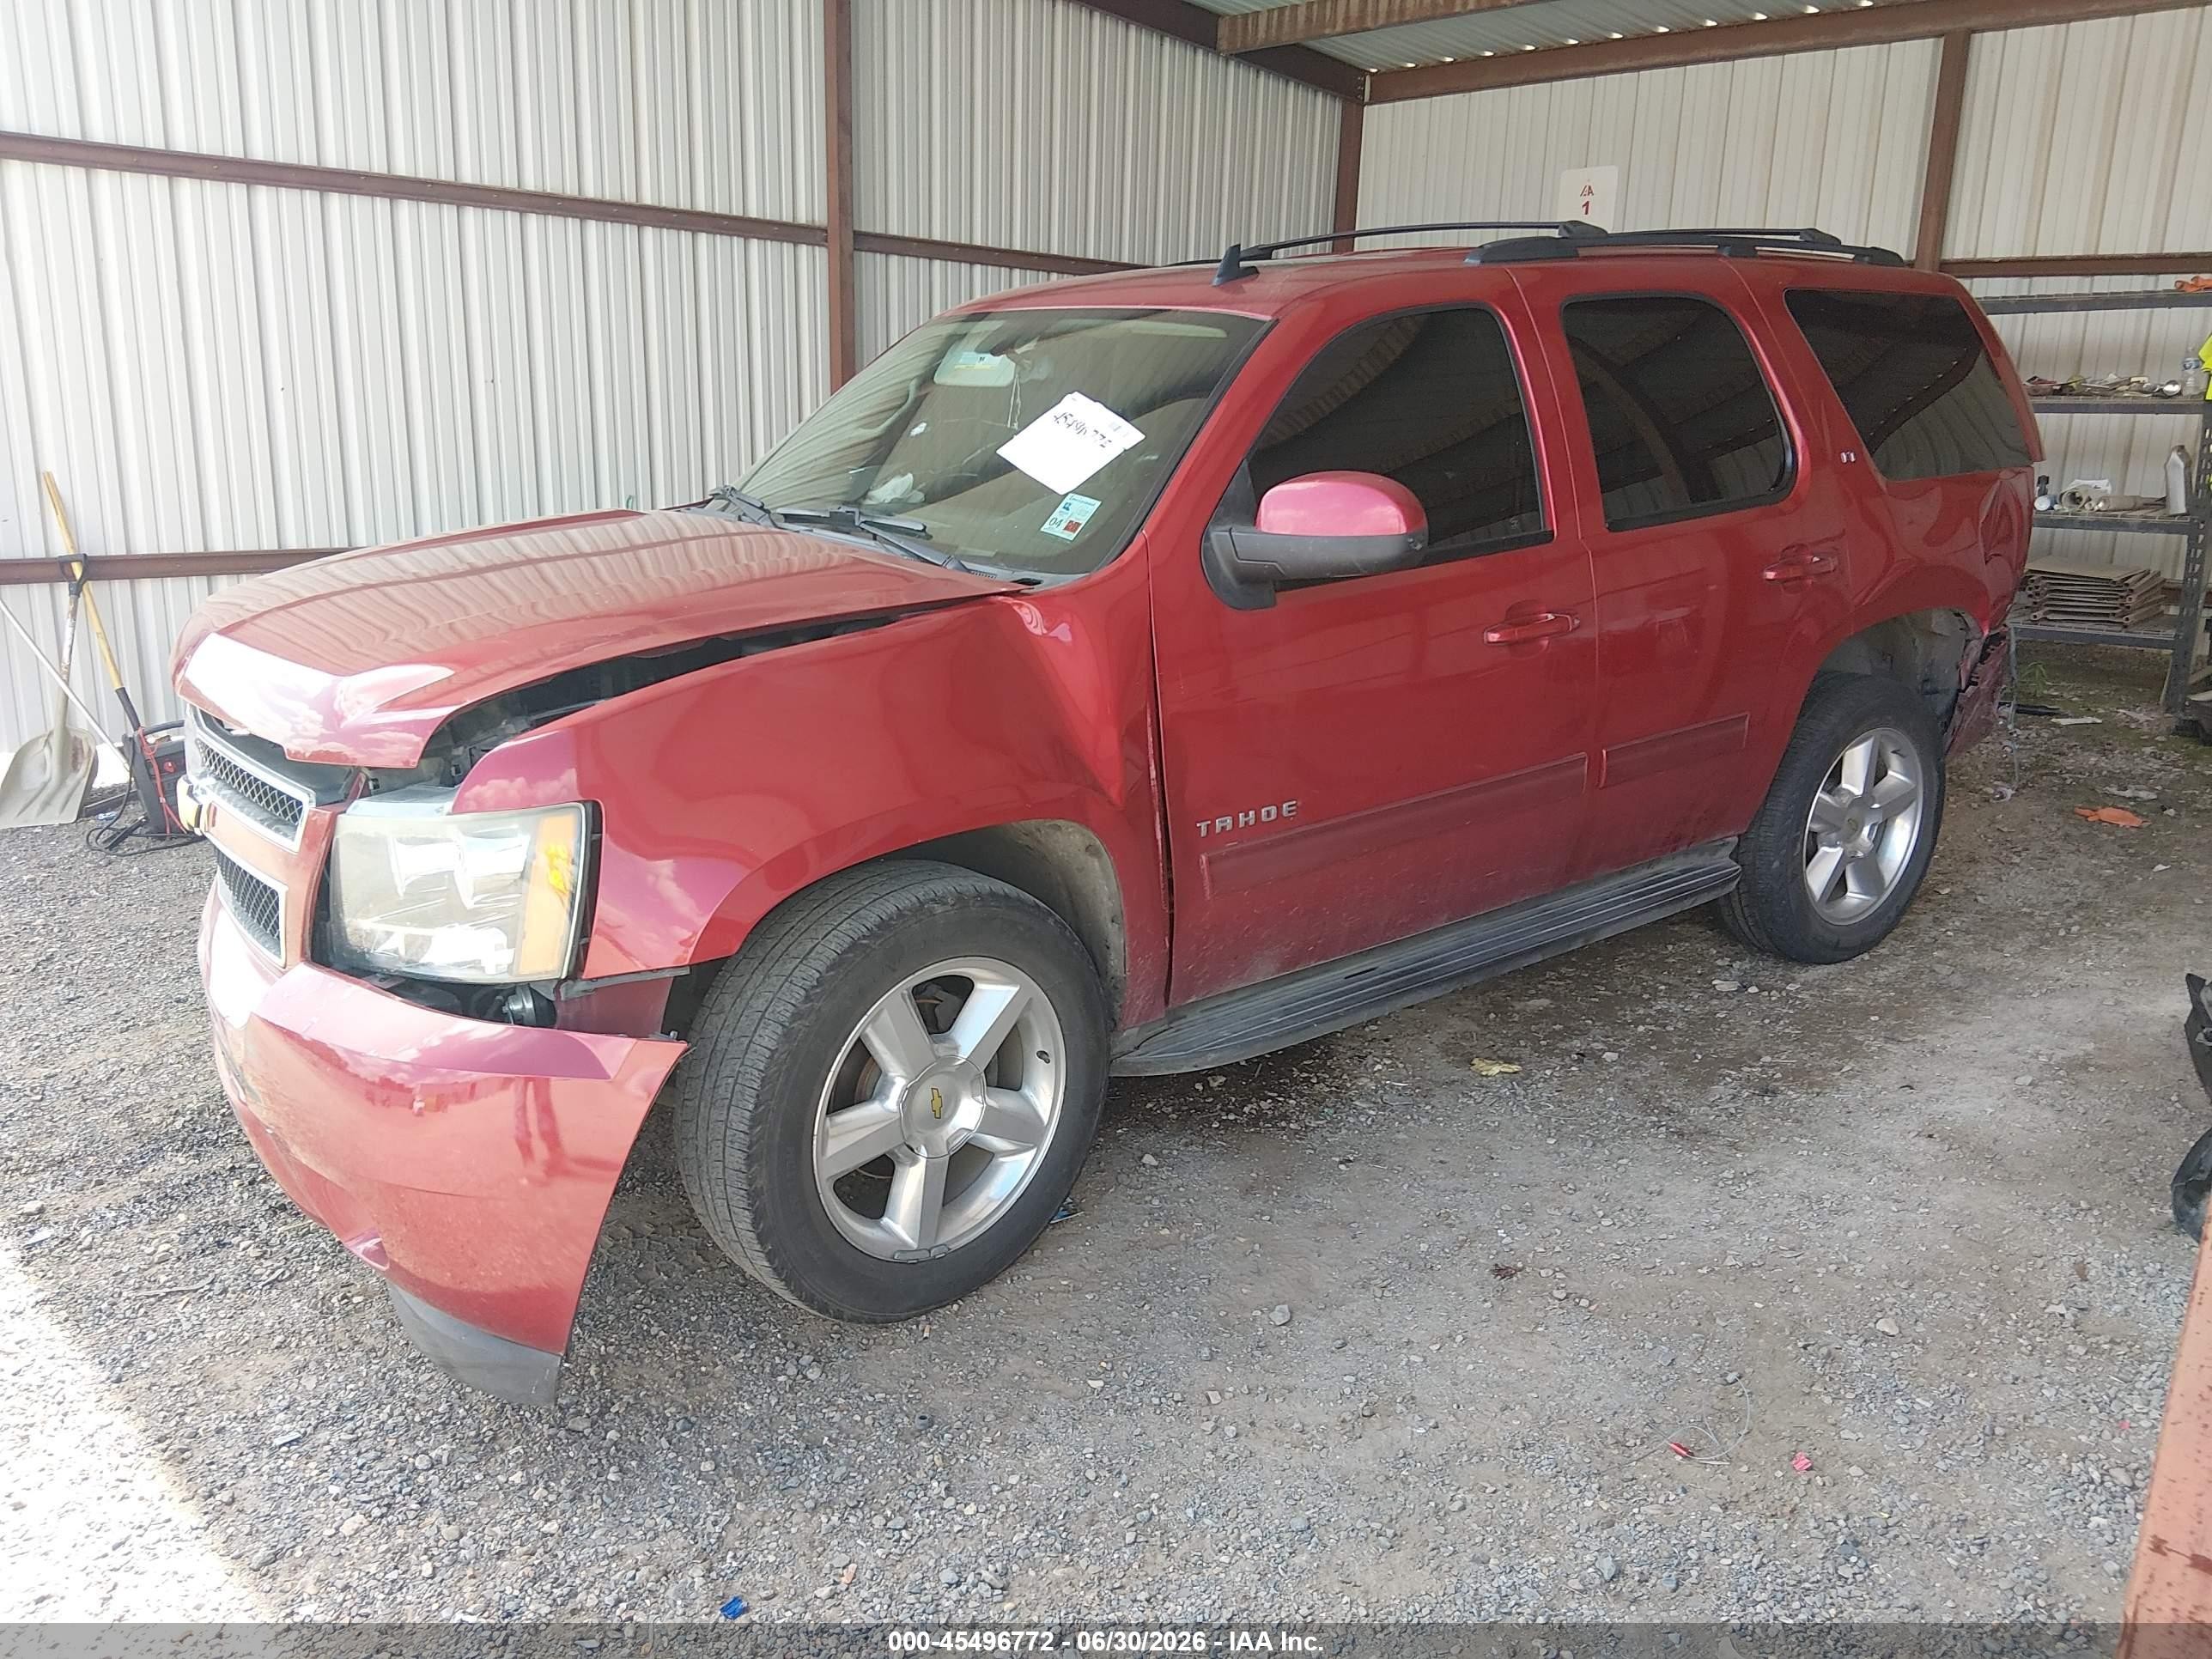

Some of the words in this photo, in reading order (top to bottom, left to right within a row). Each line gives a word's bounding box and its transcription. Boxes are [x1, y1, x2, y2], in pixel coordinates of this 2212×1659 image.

[1582, 200, 1590, 216] 1
[1048, 517, 1064, 529] 04
[1196, 800, 1297, 838] TAHOE
